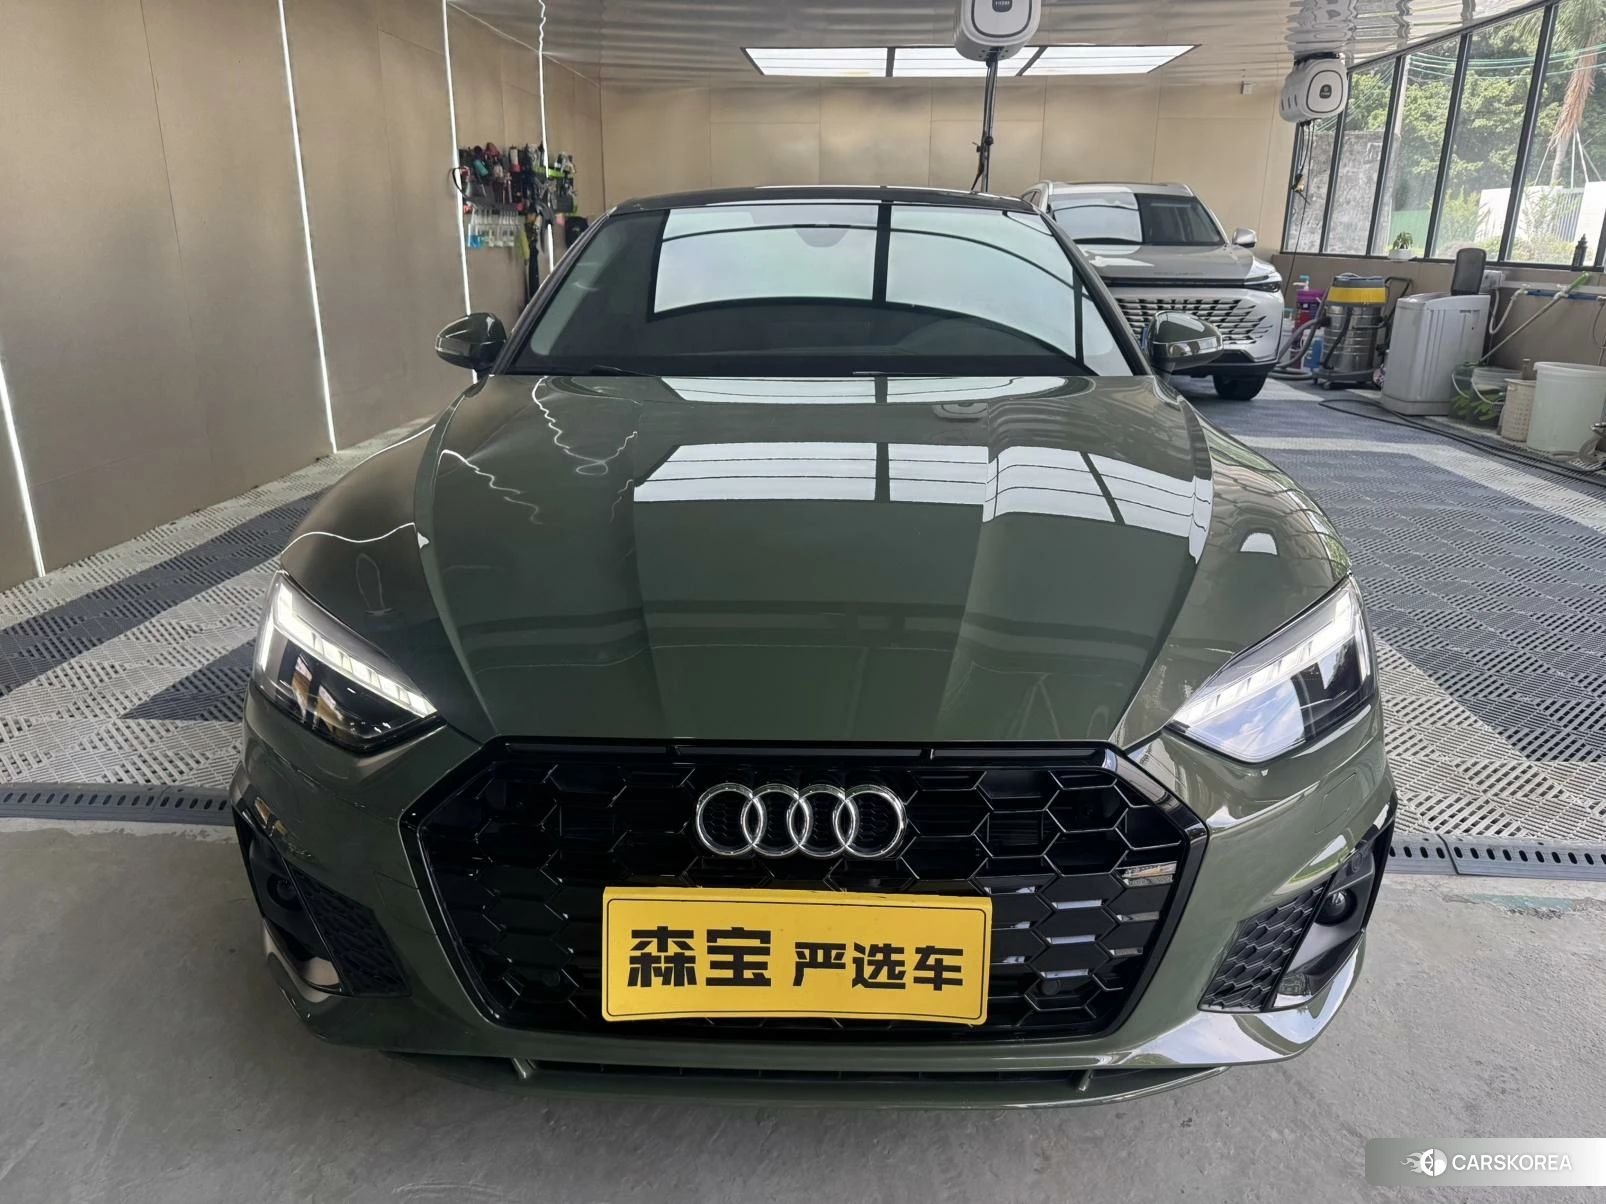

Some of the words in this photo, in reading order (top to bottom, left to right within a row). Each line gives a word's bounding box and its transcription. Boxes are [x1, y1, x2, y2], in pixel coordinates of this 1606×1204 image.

[627, 926, 772, 987] 森宝
[793, 942, 964, 991] 严选车
